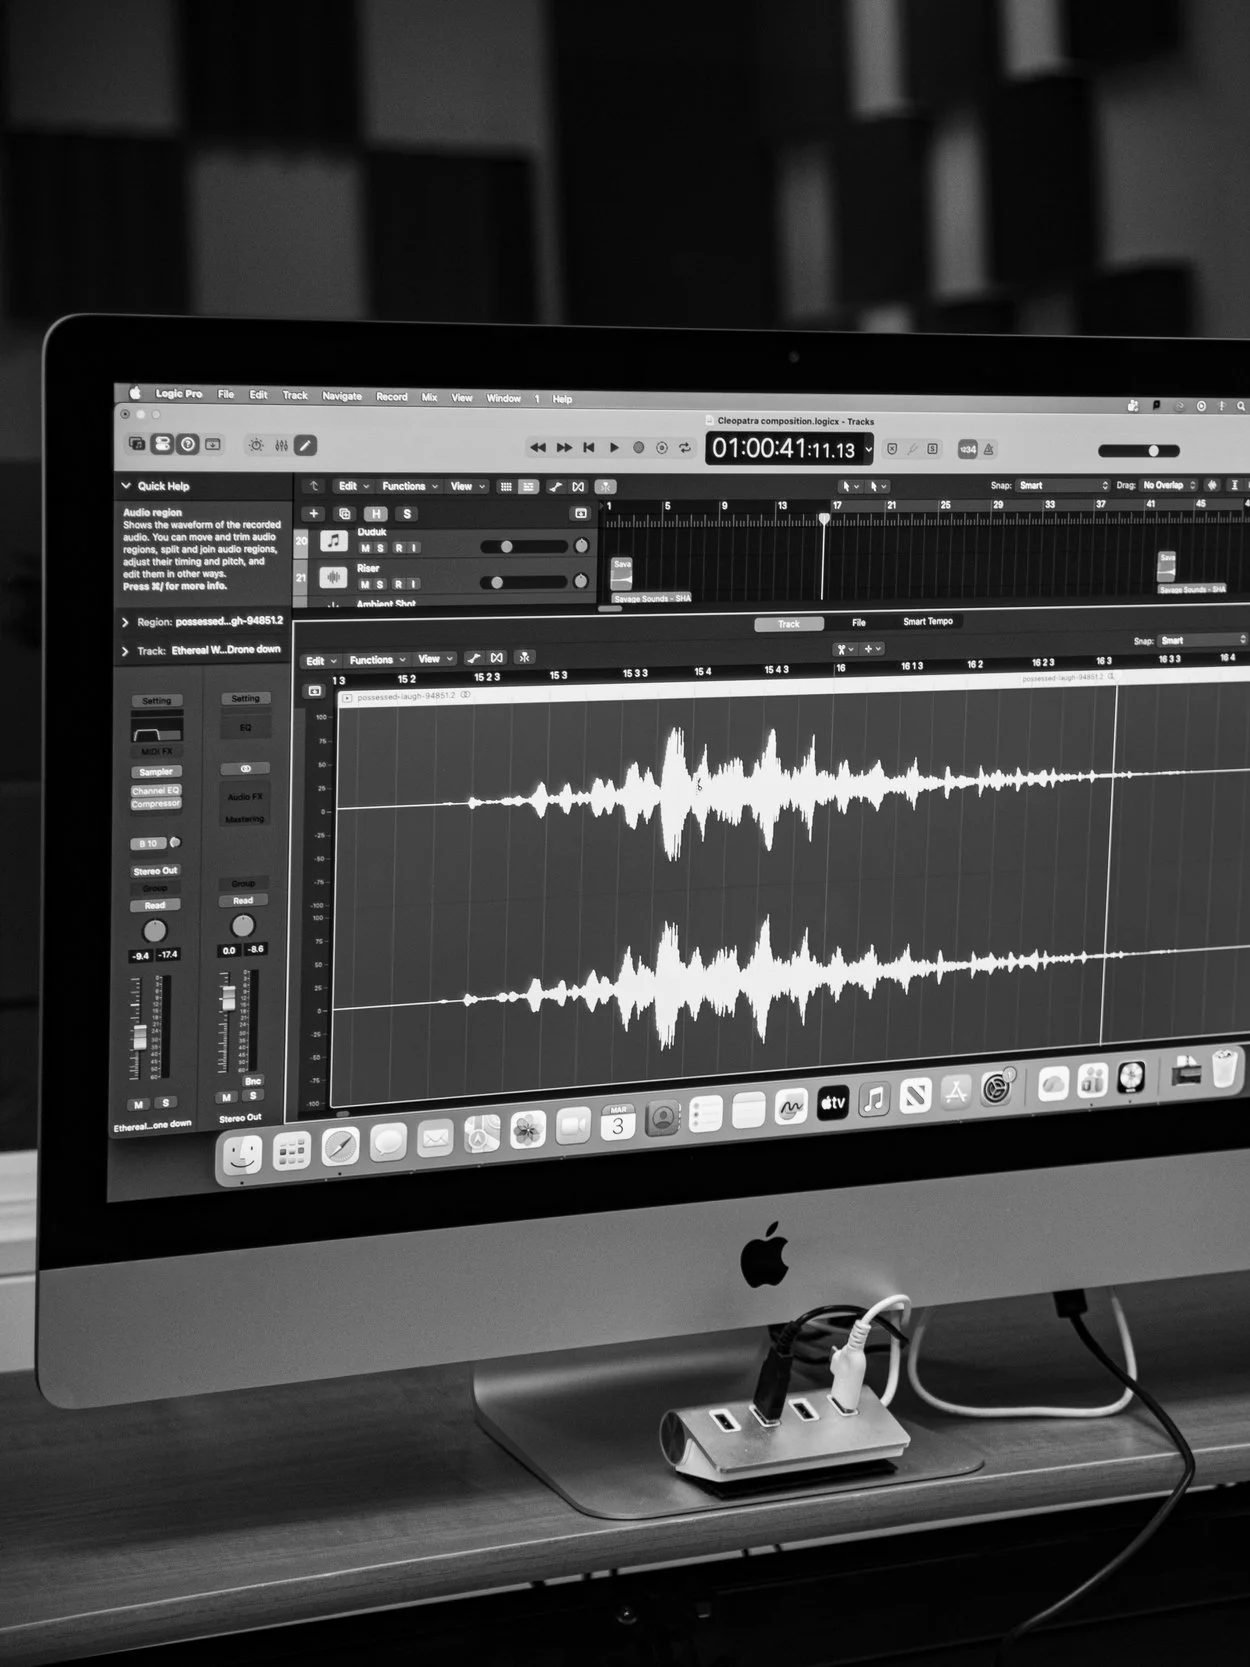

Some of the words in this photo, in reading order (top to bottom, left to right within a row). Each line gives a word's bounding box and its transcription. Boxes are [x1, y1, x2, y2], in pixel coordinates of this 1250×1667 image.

[156, 389, 182, 399] Logic
[185, 390, 203, 399] Pro
[218, 390, 234, 399] File
[250, 390, 267, 400] Edit
[283, 390, 308, 400] Track
[322, 391, 362, 402] Navigate
[376, 392, 408, 401] Record
[422, 393, 437, 402] Mix
[452, 393, 472, 402] View
[487, 393, 521, 403] Window
[553, 394, 573, 405] Help
[718, 417, 759, 427] Cleopatra
[761, 417, 839, 427] composition.logicx
[847, 418, 875, 427] Tracks
[138, 481, 165, 492] Quick
[168, 481, 190, 492] Help
[339, 481, 357, 491] Edit
[383, 481, 426, 491] Functions
[451, 481, 472, 491] View
[991, 481, 1012, 491] Snap:
[1020, 481, 1042, 490] Smart
[1117, 481, 1136, 491] Drag:
[1144, 481, 1155, 490] No
[1156, 481, 1184, 491] Overlap
[607, 502, 612, 510] 1
[665, 502, 671, 510] 5
[722, 502, 728, 510] 9
[778, 502, 788, 510] 13
[833, 502, 842, 510] 17
[888, 501, 896, 510] 21
[941, 501, 951, 509] 25
[993, 501, 1004, 509] 29
[1045, 500, 1055, 509] 33
[1096, 500, 1106, 508] 37
[1146, 500, 1155, 508] 41
[1196, 500, 1206, 508] 45
[124, 508, 150, 517] Audio
[152, 508, 182, 519] region
[372, 509, 380, 518] H
[403, 509, 412, 519] S
[123, 521, 152, 529] Shows
[154, 521, 168, 529] the
[171, 521, 213, 529] waveform
[215, 521, 225, 529] of
[227, 521, 240, 529] the
[243, 521, 281, 529] recorded
[123, 533, 149, 542] audio.
[152, 533, 168, 542] You
[215, 533, 231, 542] and
[233, 533, 250, 542] trim
[252, 533, 276, 542] audio
[296, 537, 308, 545] 20
[123, 545, 158, 555] regions,
[161, 545, 179, 555] split
[182, 545, 198, 554] and
[200, 545, 215, 555] join
[218, 545, 241, 554] audio
[244, 545, 278, 555] regions,
[123, 558, 150, 567] adjust
[152, 558, 172, 566] their
[175, 558, 201, 567] timing
[204, 558, 220, 566] and
[222, 558, 246, 567] pitch,
[249, 558, 265, 566] and
[357, 564, 379, 573] Riser
[123, 570, 140, 579] edit
[142, 570, 165, 579] them
[167, 570, 175, 579] in
[177, 570, 200, 579] other
[202, 571, 227, 580] ways.
[295, 574, 306, 582] 21
[123, 582, 150, 591] Press
[165, 582, 179, 591] for
[207, 582, 228, 591] info.
[138, 617, 173, 628] Region:
[778, 620, 800, 629] Track
[852, 618, 866, 627] File
[903, 617, 926, 626] Smart
[928, 616, 953, 626] Tempo
[1134, 637, 1154, 647] Snap:
[1162, 636, 1184, 645] Smart
[138, 646, 166, 655] Track:
[171, 645, 209, 655] Ethereal
[256, 645, 281, 654] down
[306, 657, 324, 666] Edit
[350, 655, 393, 665] Functions
[418, 654, 440, 663] View
[836, 663, 846, 672] 16
[142, 697, 171, 706] Setting
[232, 695, 260, 704] Setting
[240, 724, 252, 732] EQ
[139, 768, 173, 778] Sampler
[132, 787, 165, 796] Channel
[167, 786, 180, 795] EQ
[227, 793, 250, 801] Audio
[131, 800, 181, 810] Compressor
[225, 815, 265, 825] Mastering
[133, 867, 160, 876] Stereo
[162, 866, 178, 875] Out
[143, 885, 168, 894] Group
[231, 880, 256, 889] Group
[144, 902, 166, 910] Read
[233, 897, 254, 905] Read
[222, 947, 235, 955] 0.0
[248, 945, 264, 954] -8.6
[132, 952, 150, 960] -9.4
[158, 951, 178, 959] -17.4
[245, 1077, 261, 1085] Bnc
[222, 1094, 231, 1102] M
[250, 1092, 257, 1100] S
[134, 1101, 143, 1109] M
[163, 1099, 169, 1107] S
[611, 1106, 627, 1114] MAR
[220, 1115, 245, 1123] Stereo
[247, 1113, 262, 1121] Out
[170, 1119, 192, 1128] down
[612, 1117, 624, 1135] 3
